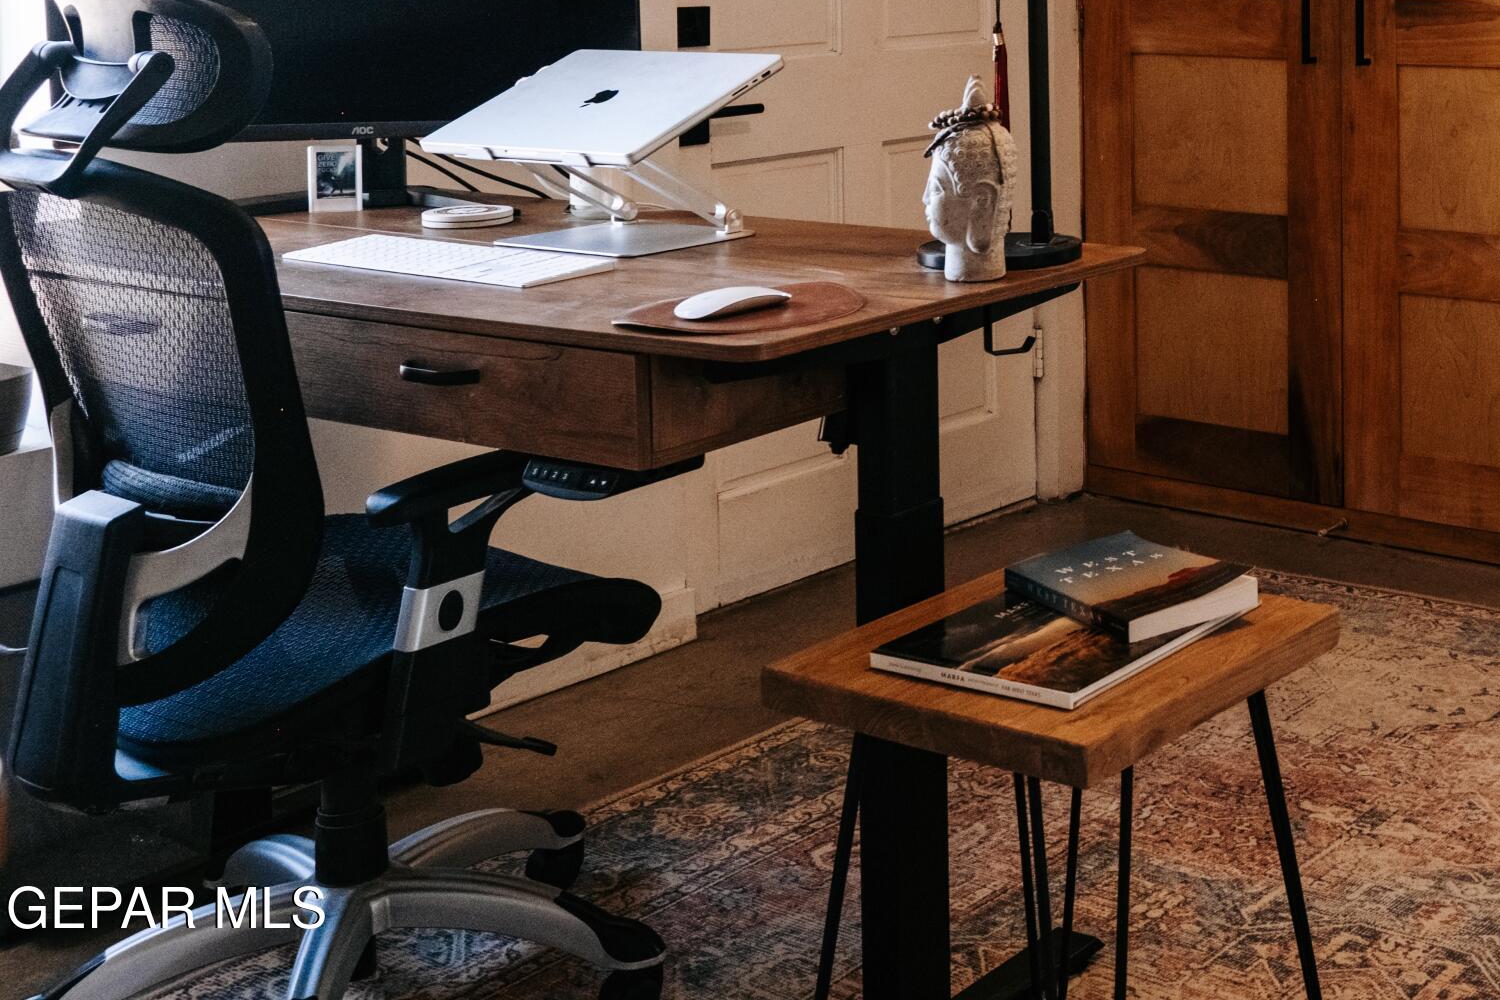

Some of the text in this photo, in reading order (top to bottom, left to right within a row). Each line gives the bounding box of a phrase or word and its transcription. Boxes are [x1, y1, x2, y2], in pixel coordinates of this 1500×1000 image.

[351, 126, 375, 135] AOC
[1054, 549, 1137, 575] WEST
[1059, 552, 1164, 584] TEXAS
[940, 671, 966, 683] MARFA
